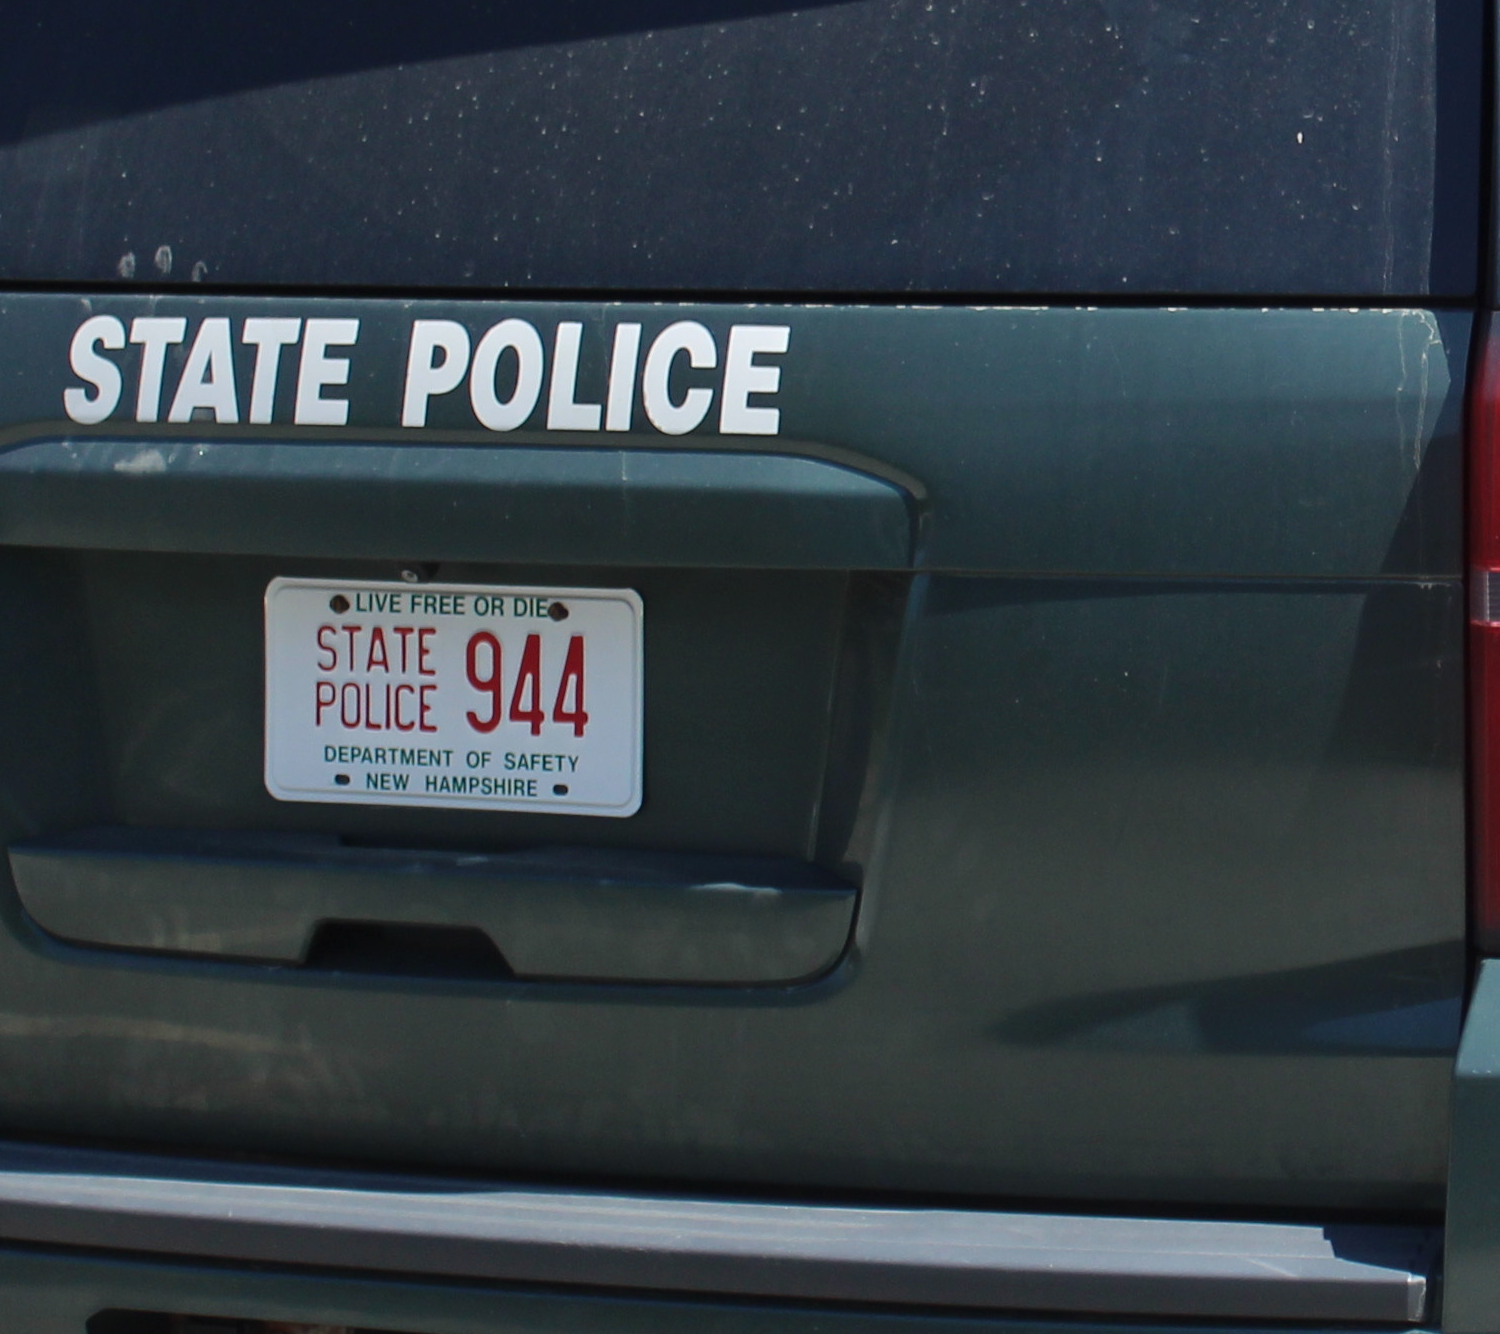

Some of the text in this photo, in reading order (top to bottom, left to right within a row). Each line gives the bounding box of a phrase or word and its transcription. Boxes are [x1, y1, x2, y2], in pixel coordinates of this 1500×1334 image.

[63, 314, 792, 436] STATE POLICE
[355, 593, 549, 617] LIVE FREE OR DIE
[317, 625, 437, 676] STATE
[315, 681, 438, 732] POLICE
[466, 631, 589, 738] 944
[324, 745, 579, 772] DEPARTMENT OF SAFETY
[366, 773, 538, 797] NEW HAMPSHIRE
